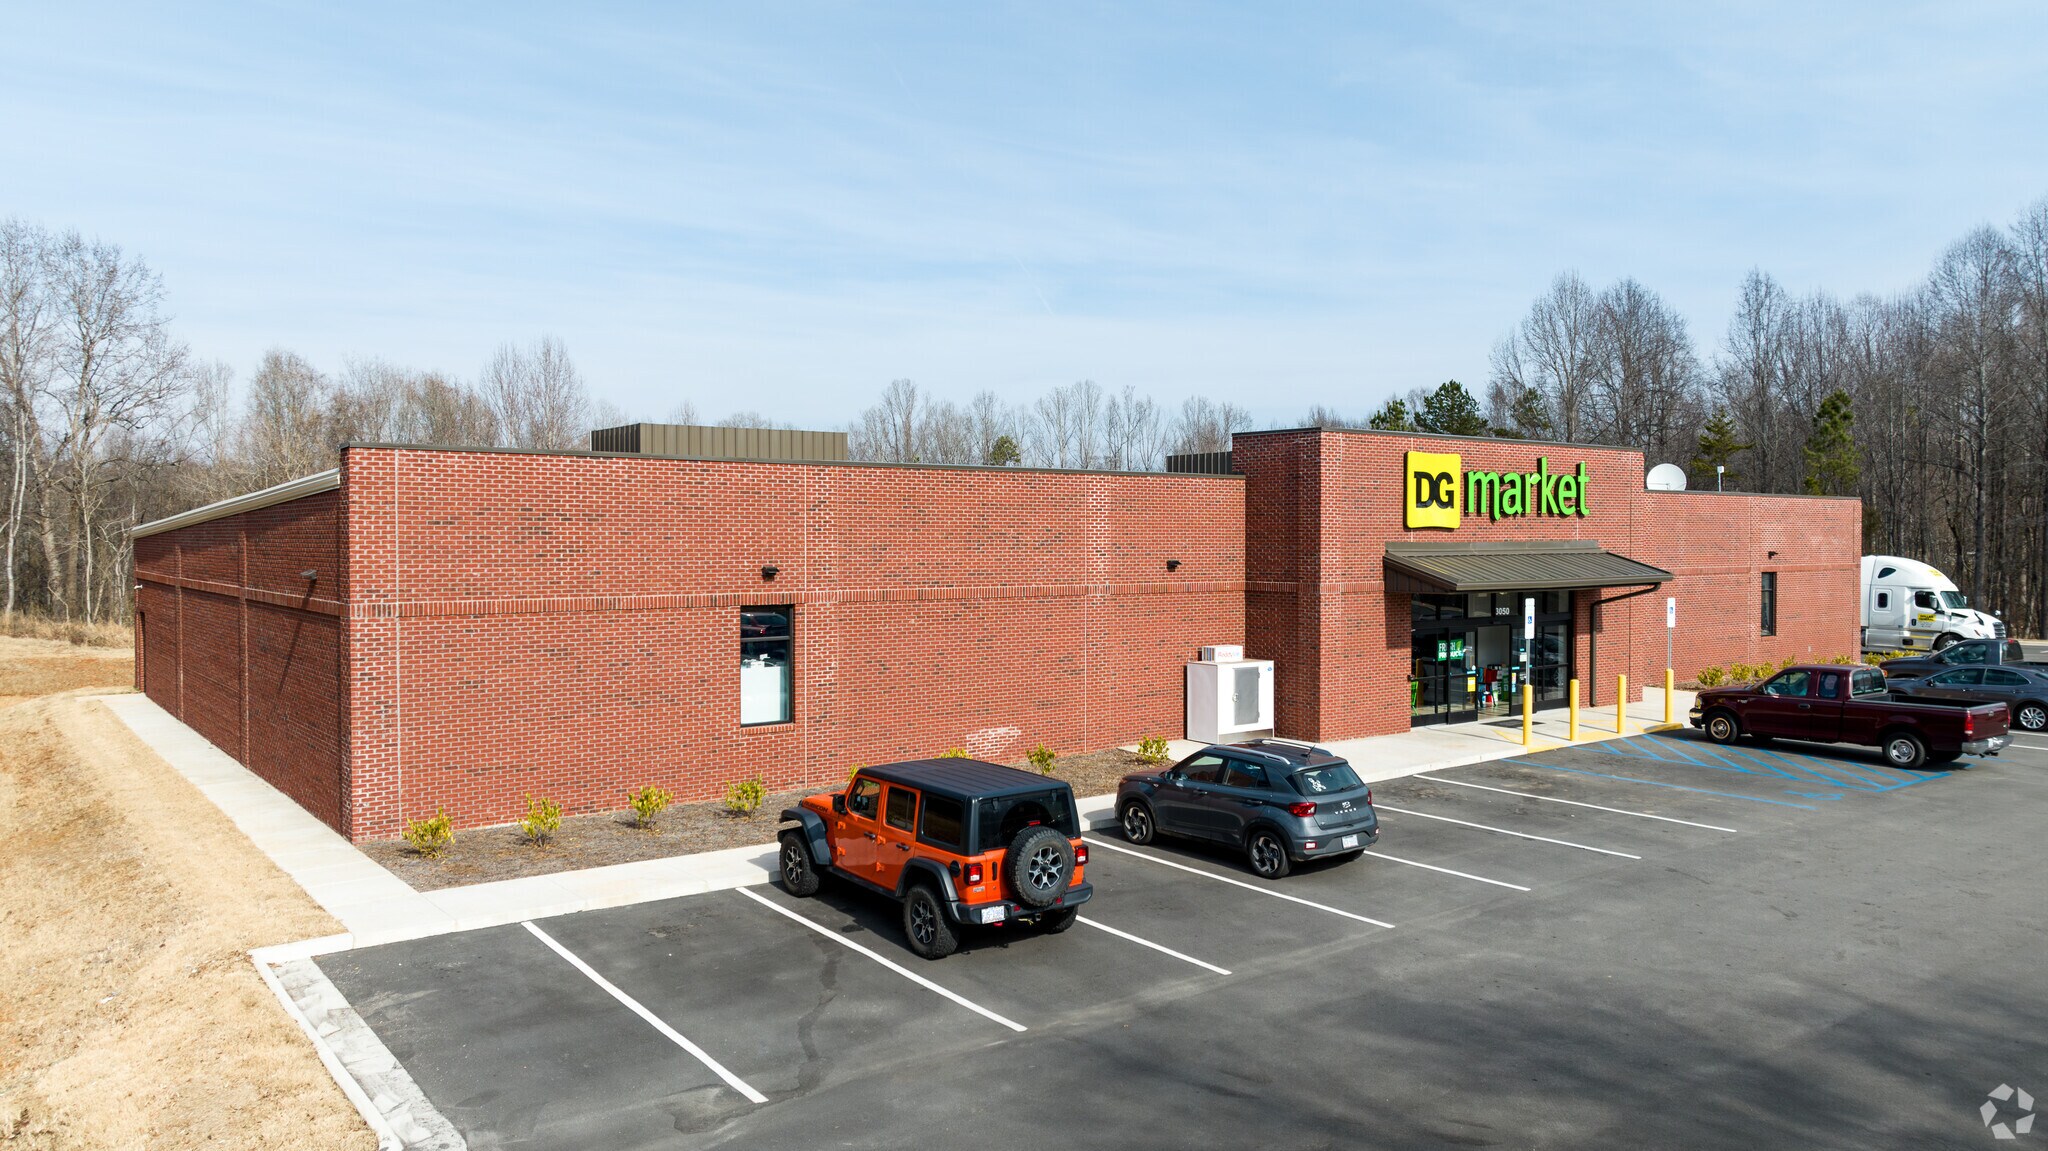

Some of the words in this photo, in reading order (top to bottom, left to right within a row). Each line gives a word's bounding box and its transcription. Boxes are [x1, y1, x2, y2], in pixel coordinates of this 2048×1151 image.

[1413, 470, 1455, 509] DG
[1465, 455, 1591, 522] market
[1495, 607, 1510, 616] 3050
